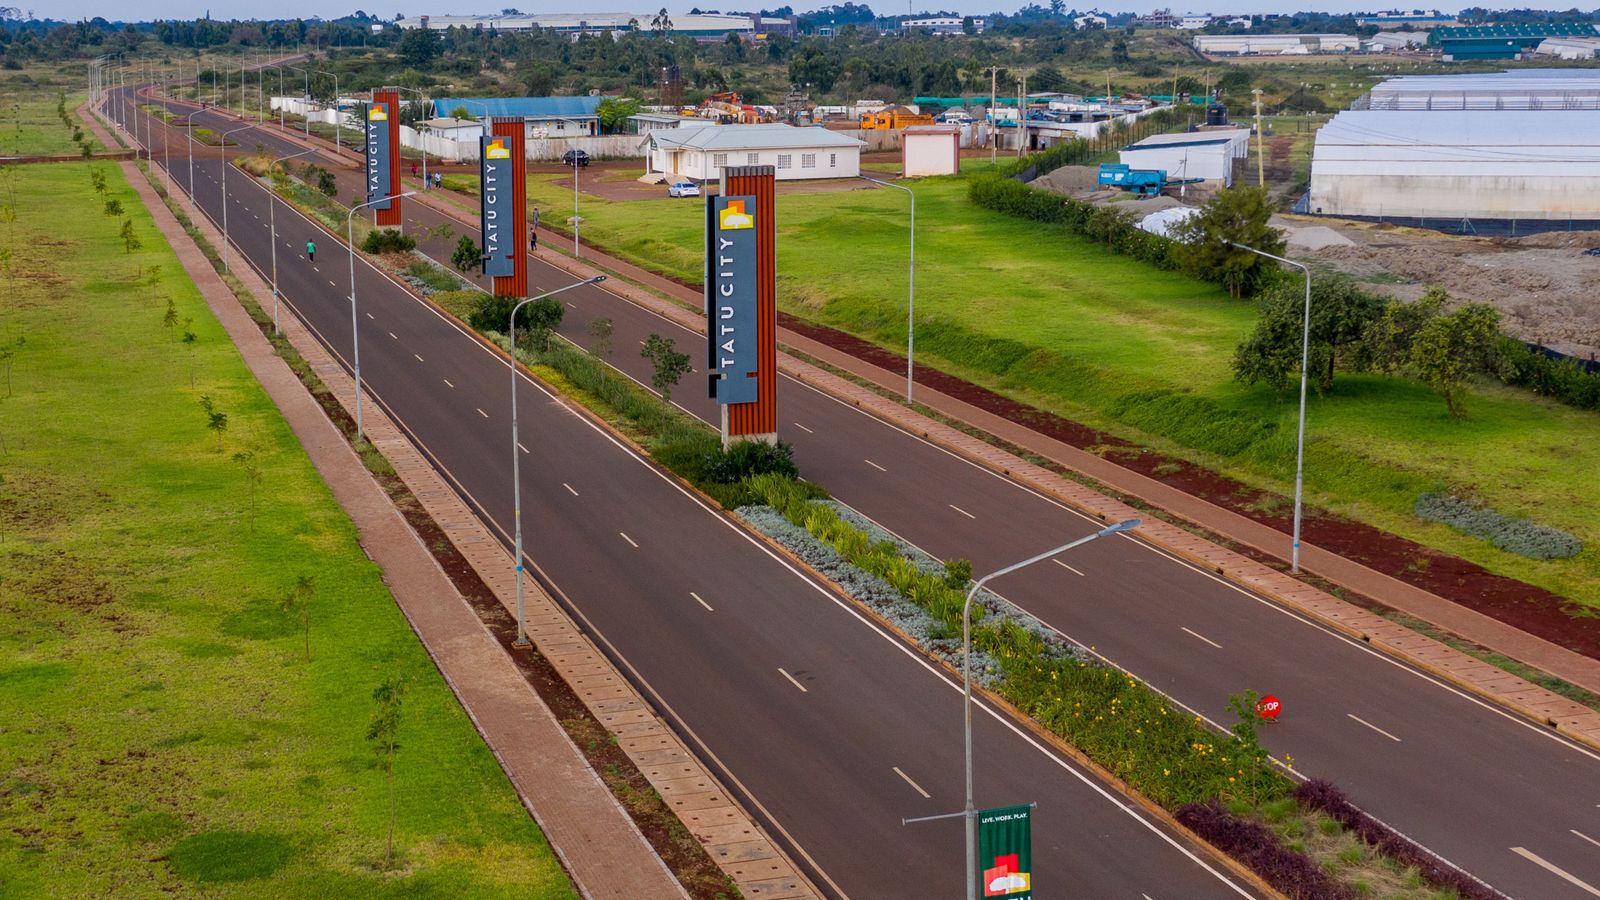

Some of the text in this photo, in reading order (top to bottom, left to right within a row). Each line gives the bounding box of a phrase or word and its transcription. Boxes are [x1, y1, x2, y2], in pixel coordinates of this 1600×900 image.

[370, 158, 378, 191] TATU
[487, 164, 498, 253] TATU CITY
[720, 237, 735, 368] TATU CITY
